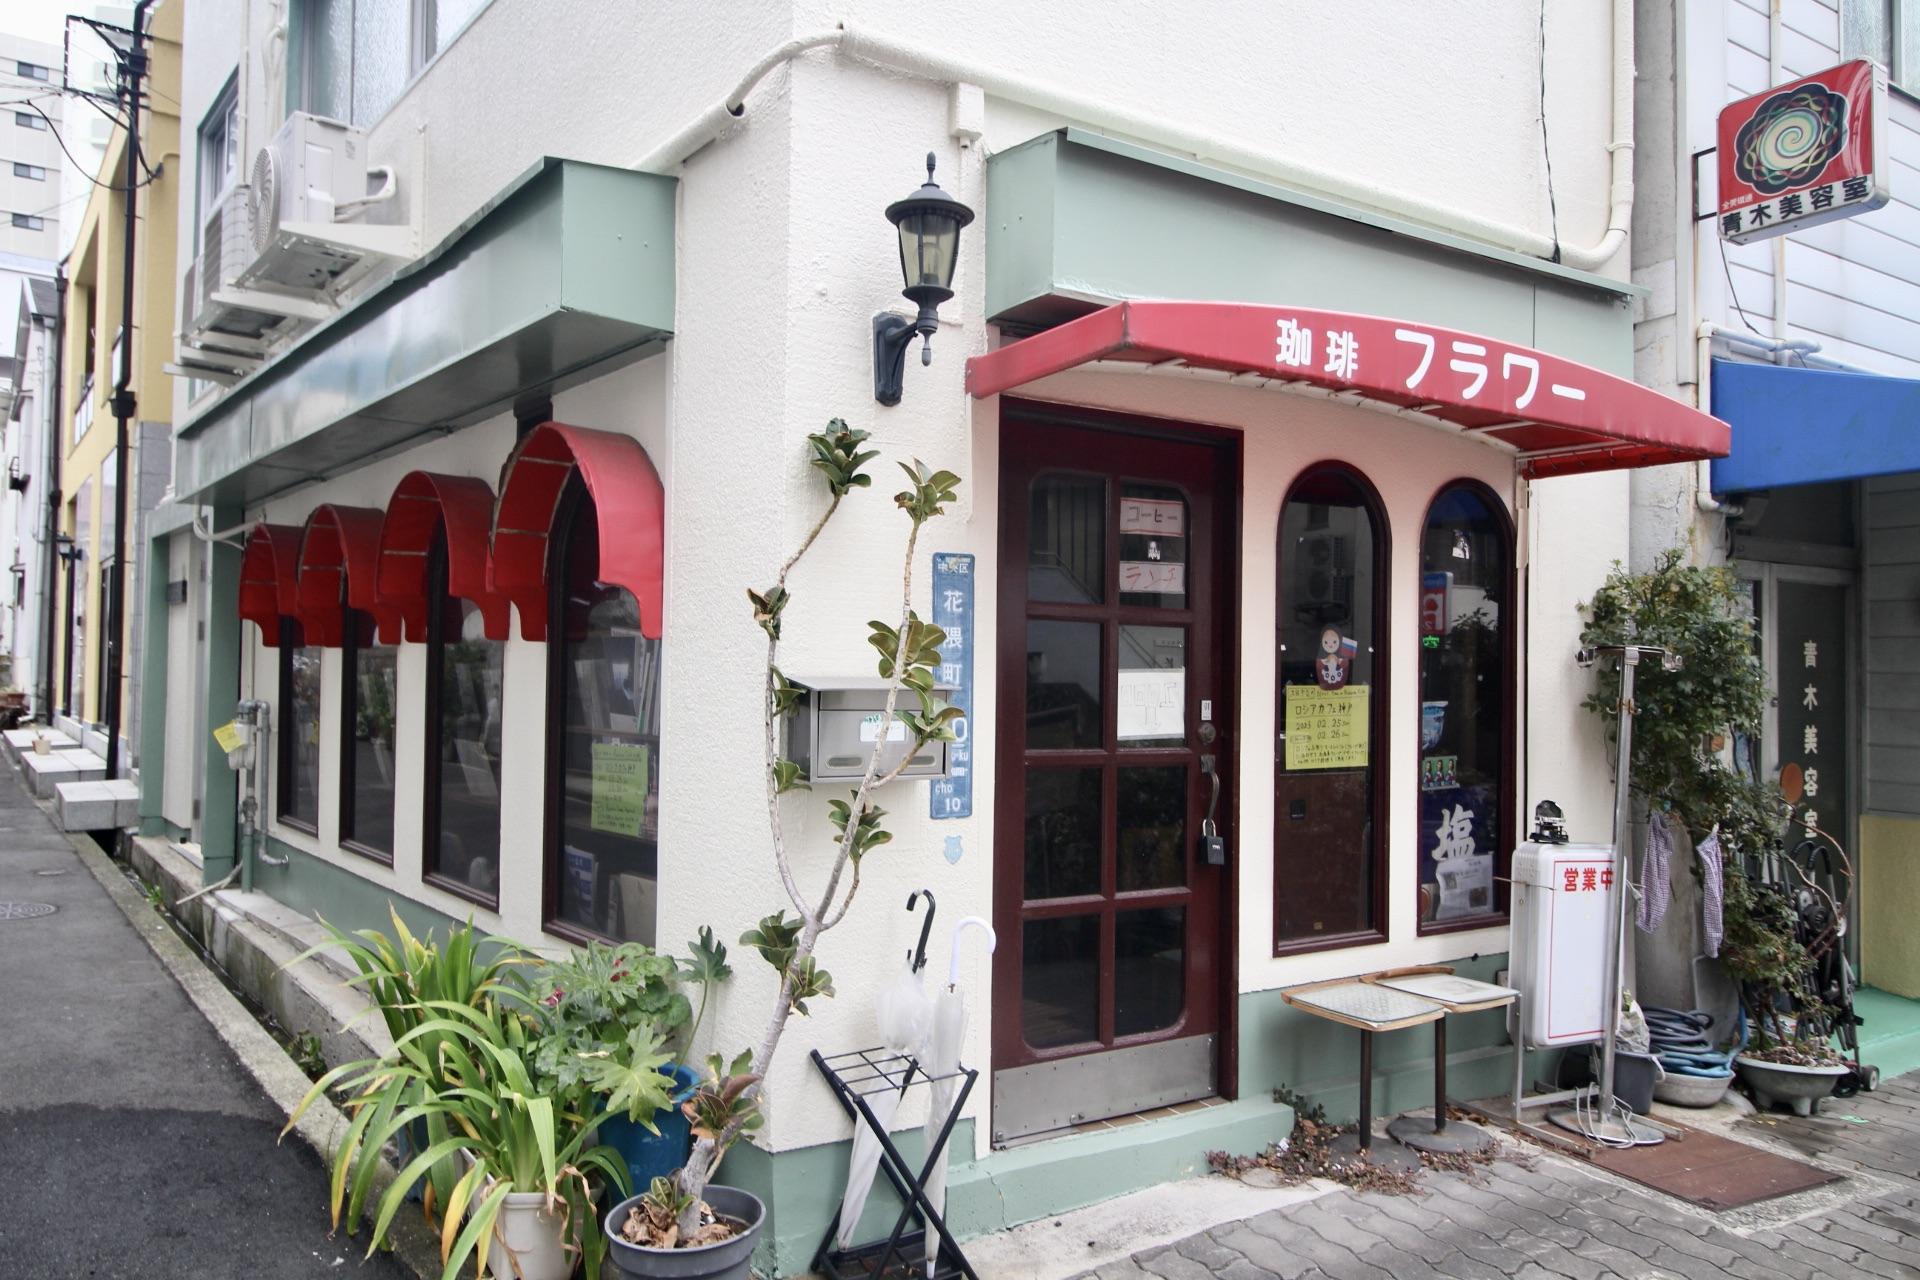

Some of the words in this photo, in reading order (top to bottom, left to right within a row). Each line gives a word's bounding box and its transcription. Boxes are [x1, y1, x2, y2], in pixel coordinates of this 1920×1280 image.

[1722, 175, 1869, 235] 青木美容室
[1276, 318, 1359, 379] 珈琲
[1395, 328, 1586, 410] フラワー
[1126, 506, 1178, 524] コーヒー
[1125, 565, 1177, 590] ランチ
[942, 589, 964, 684] 花隈町
[1803, 639, 1819, 839] 青木美容室
[944, 797, 961, 812] 10
[1432, 803, 1476, 861] 塩
[1564, 867, 1614, 892] 営業中
